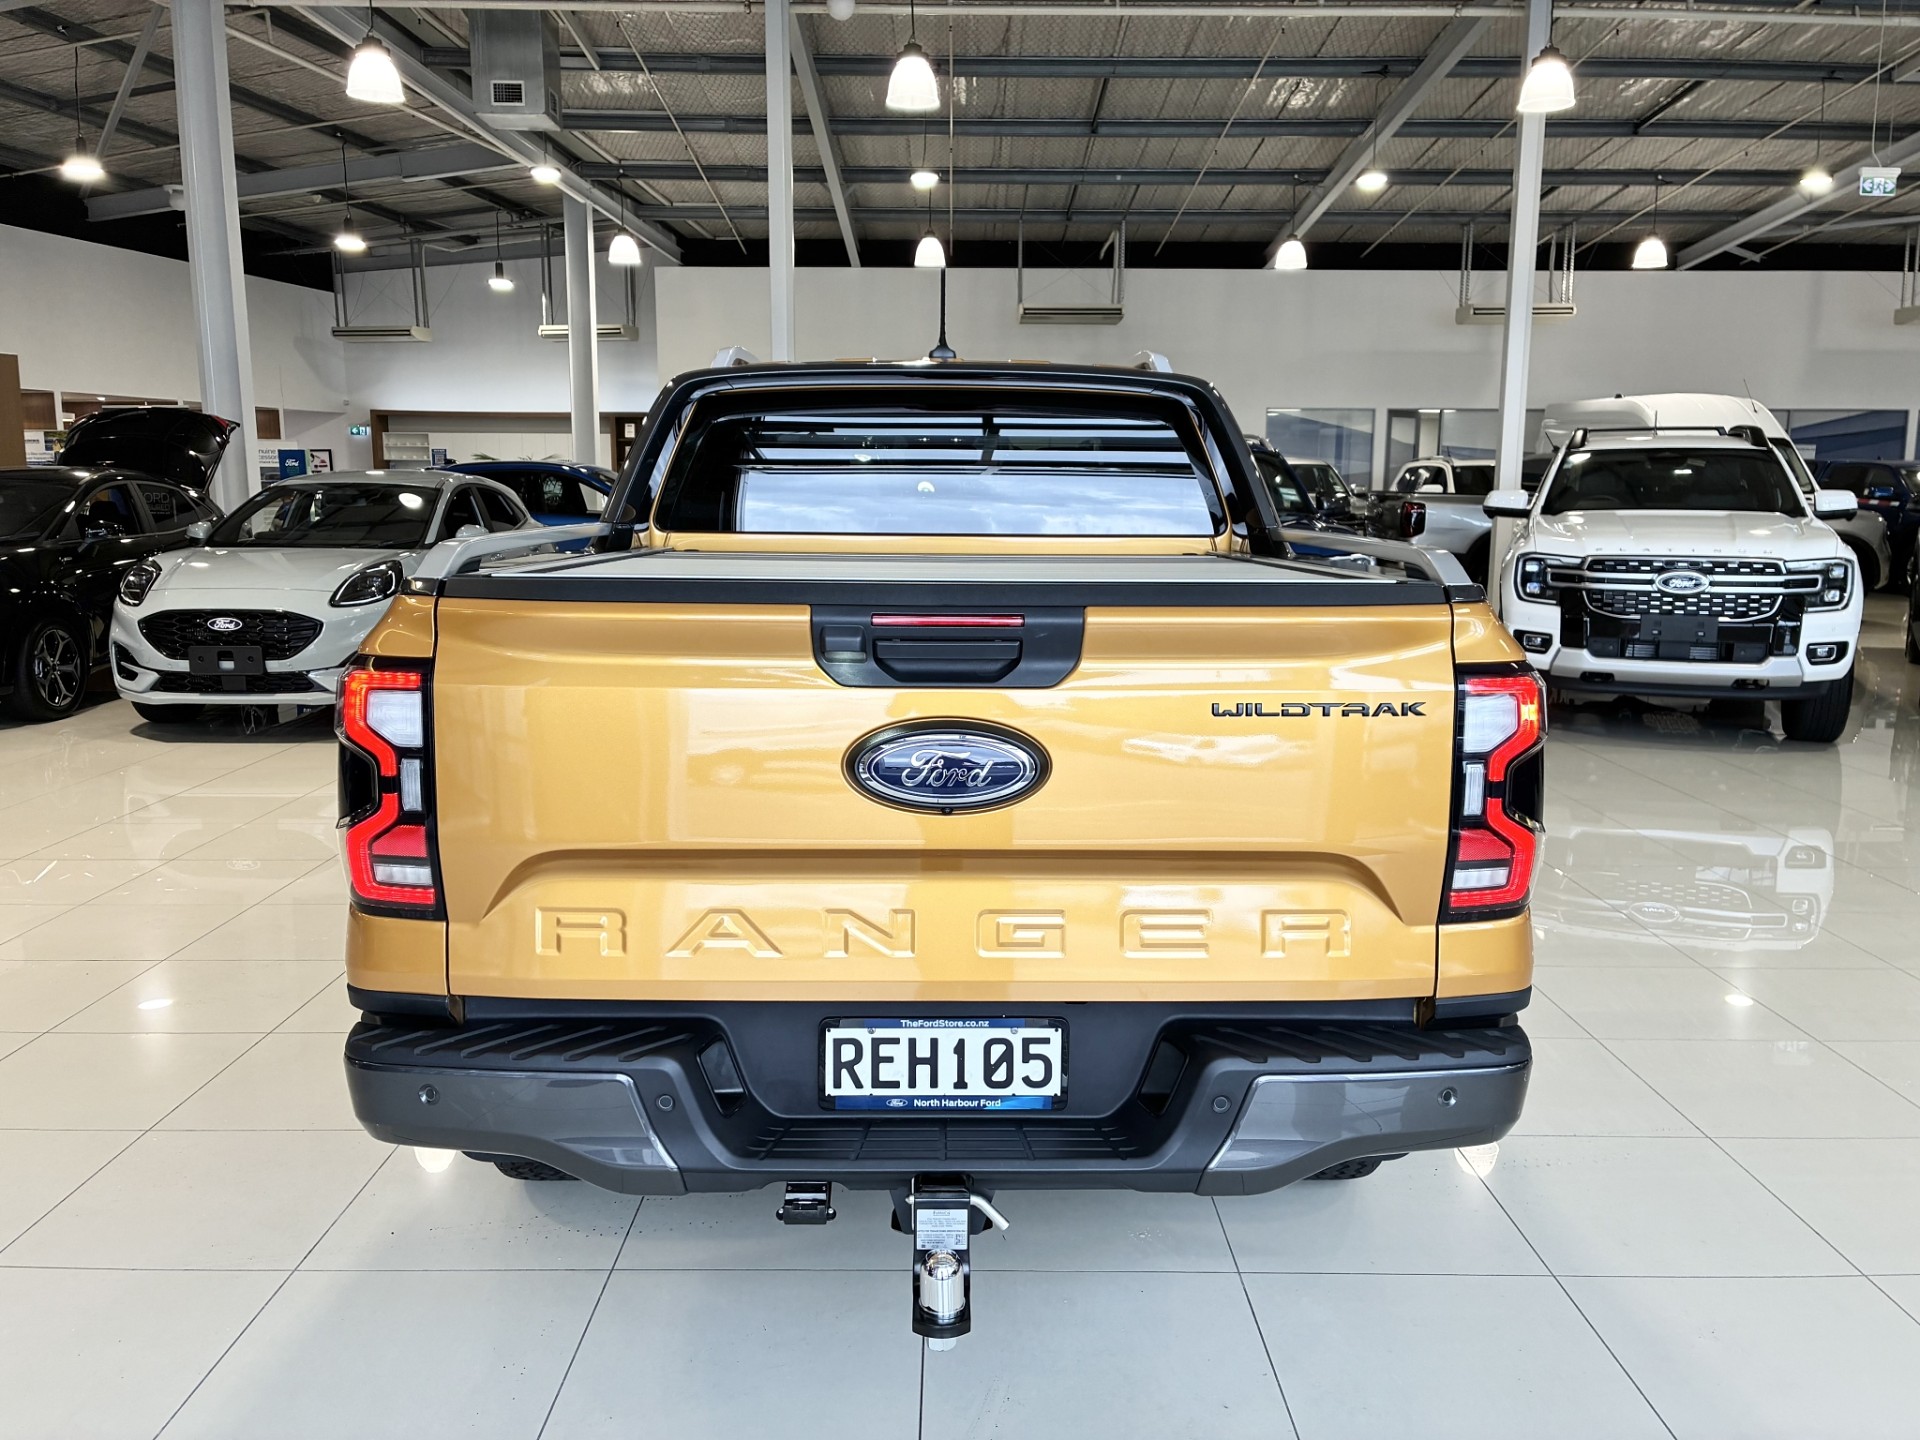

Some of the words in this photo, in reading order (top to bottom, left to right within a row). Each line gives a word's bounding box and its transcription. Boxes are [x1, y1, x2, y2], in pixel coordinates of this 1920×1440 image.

[285, 458, 299, 467] Ford
[143, 492, 170, 504] ORD
[1669, 577, 1696, 589] Ford
[213, 619, 236, 629] Ford
[1211, 702, 1427, 717] WILDTRAK
[901, 749, 994, 787] Ford
[535, 906, 1352, 959] RANGER
[900, 1019, 990, 1028] TheFordStore.co.nz
[832, 1037, 1053, 1089] REH105
[913, 1098, 940, 1107] North
[941, 1098, 979, 1107] Harbour
[980, 1098, 1001, 1107] Ford
